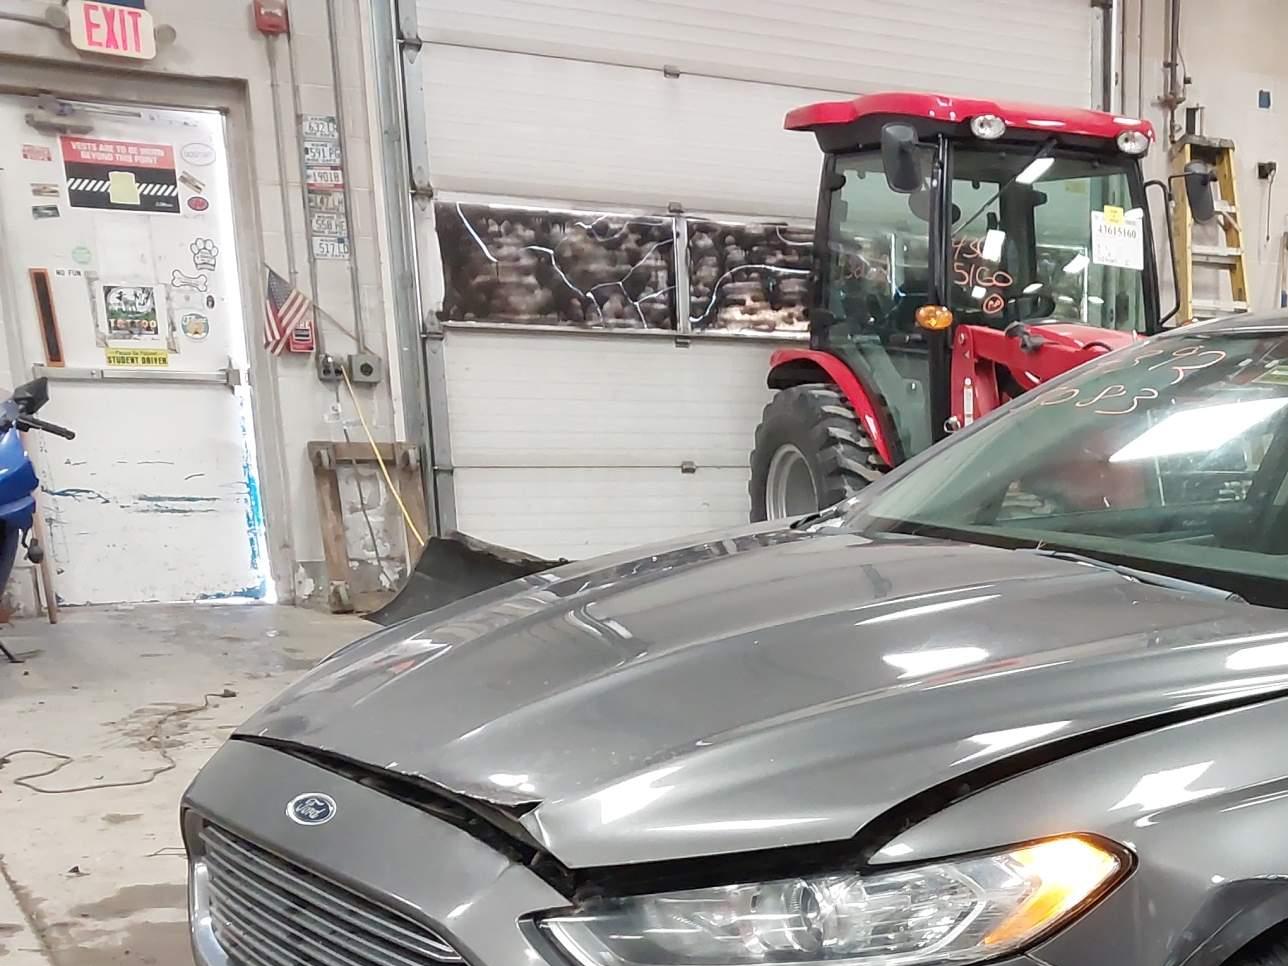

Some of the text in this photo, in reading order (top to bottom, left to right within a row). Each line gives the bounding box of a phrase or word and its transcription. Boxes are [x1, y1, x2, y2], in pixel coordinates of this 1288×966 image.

[83, 3, 142, 53] EXIT
[80, 151, 114, 161] BEYOND
[107, 355, 168, 365] STUDENT DRIVER
[295, 798, 326, 819] Ford
